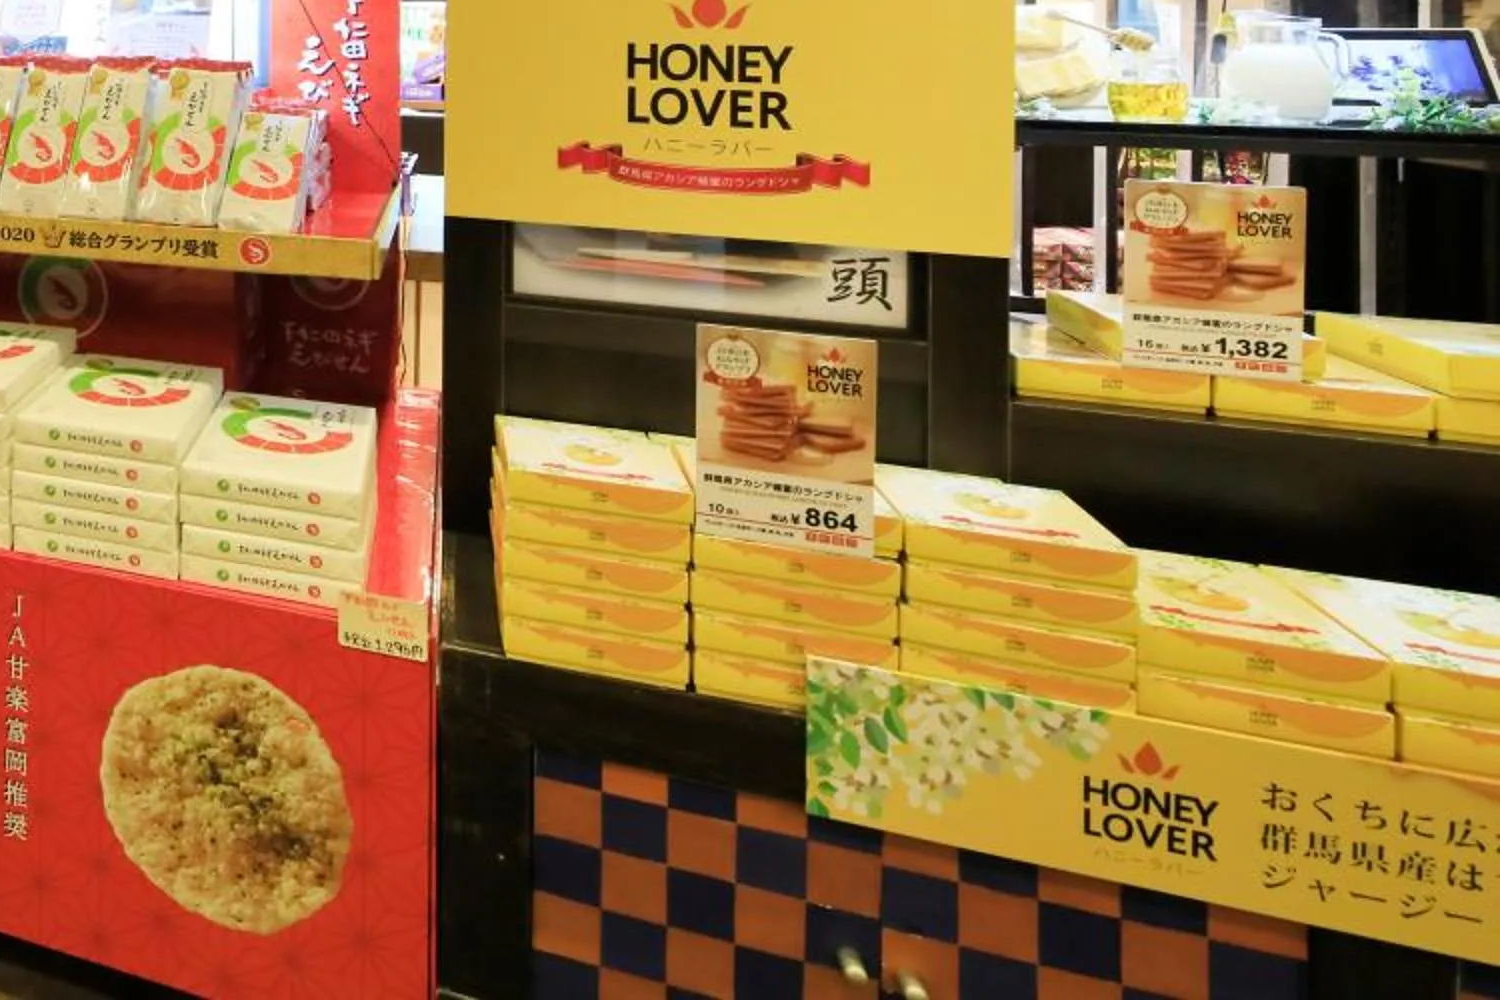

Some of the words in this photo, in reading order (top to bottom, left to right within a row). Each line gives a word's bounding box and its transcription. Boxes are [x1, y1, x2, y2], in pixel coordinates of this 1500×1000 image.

[627, 43, 793, 85] HONEY
[627, 87, 792, 131] LOVER
[643, 138, 774, 157] ハニーラバー
[1237, 211, 1293, 225] HONEY
[1237, 225, 1293, 239] LOVER
[827, 257, 892, 311] 頭
[807, 365, 863, 382] HONEY
[807, 380, 863, 397] LOVER
[3, 595, 29, 841] JA甘楽富岡推奨
[1084, 776, 1219, 827] HONEY
[1261, 783, 1500, 854] おくちに広
[1084, 808, 1218, 862] LOVER
[1261, 823, 1500, 892] 群馬県産は
[1261, 865, 1484, 924] ジャージー
